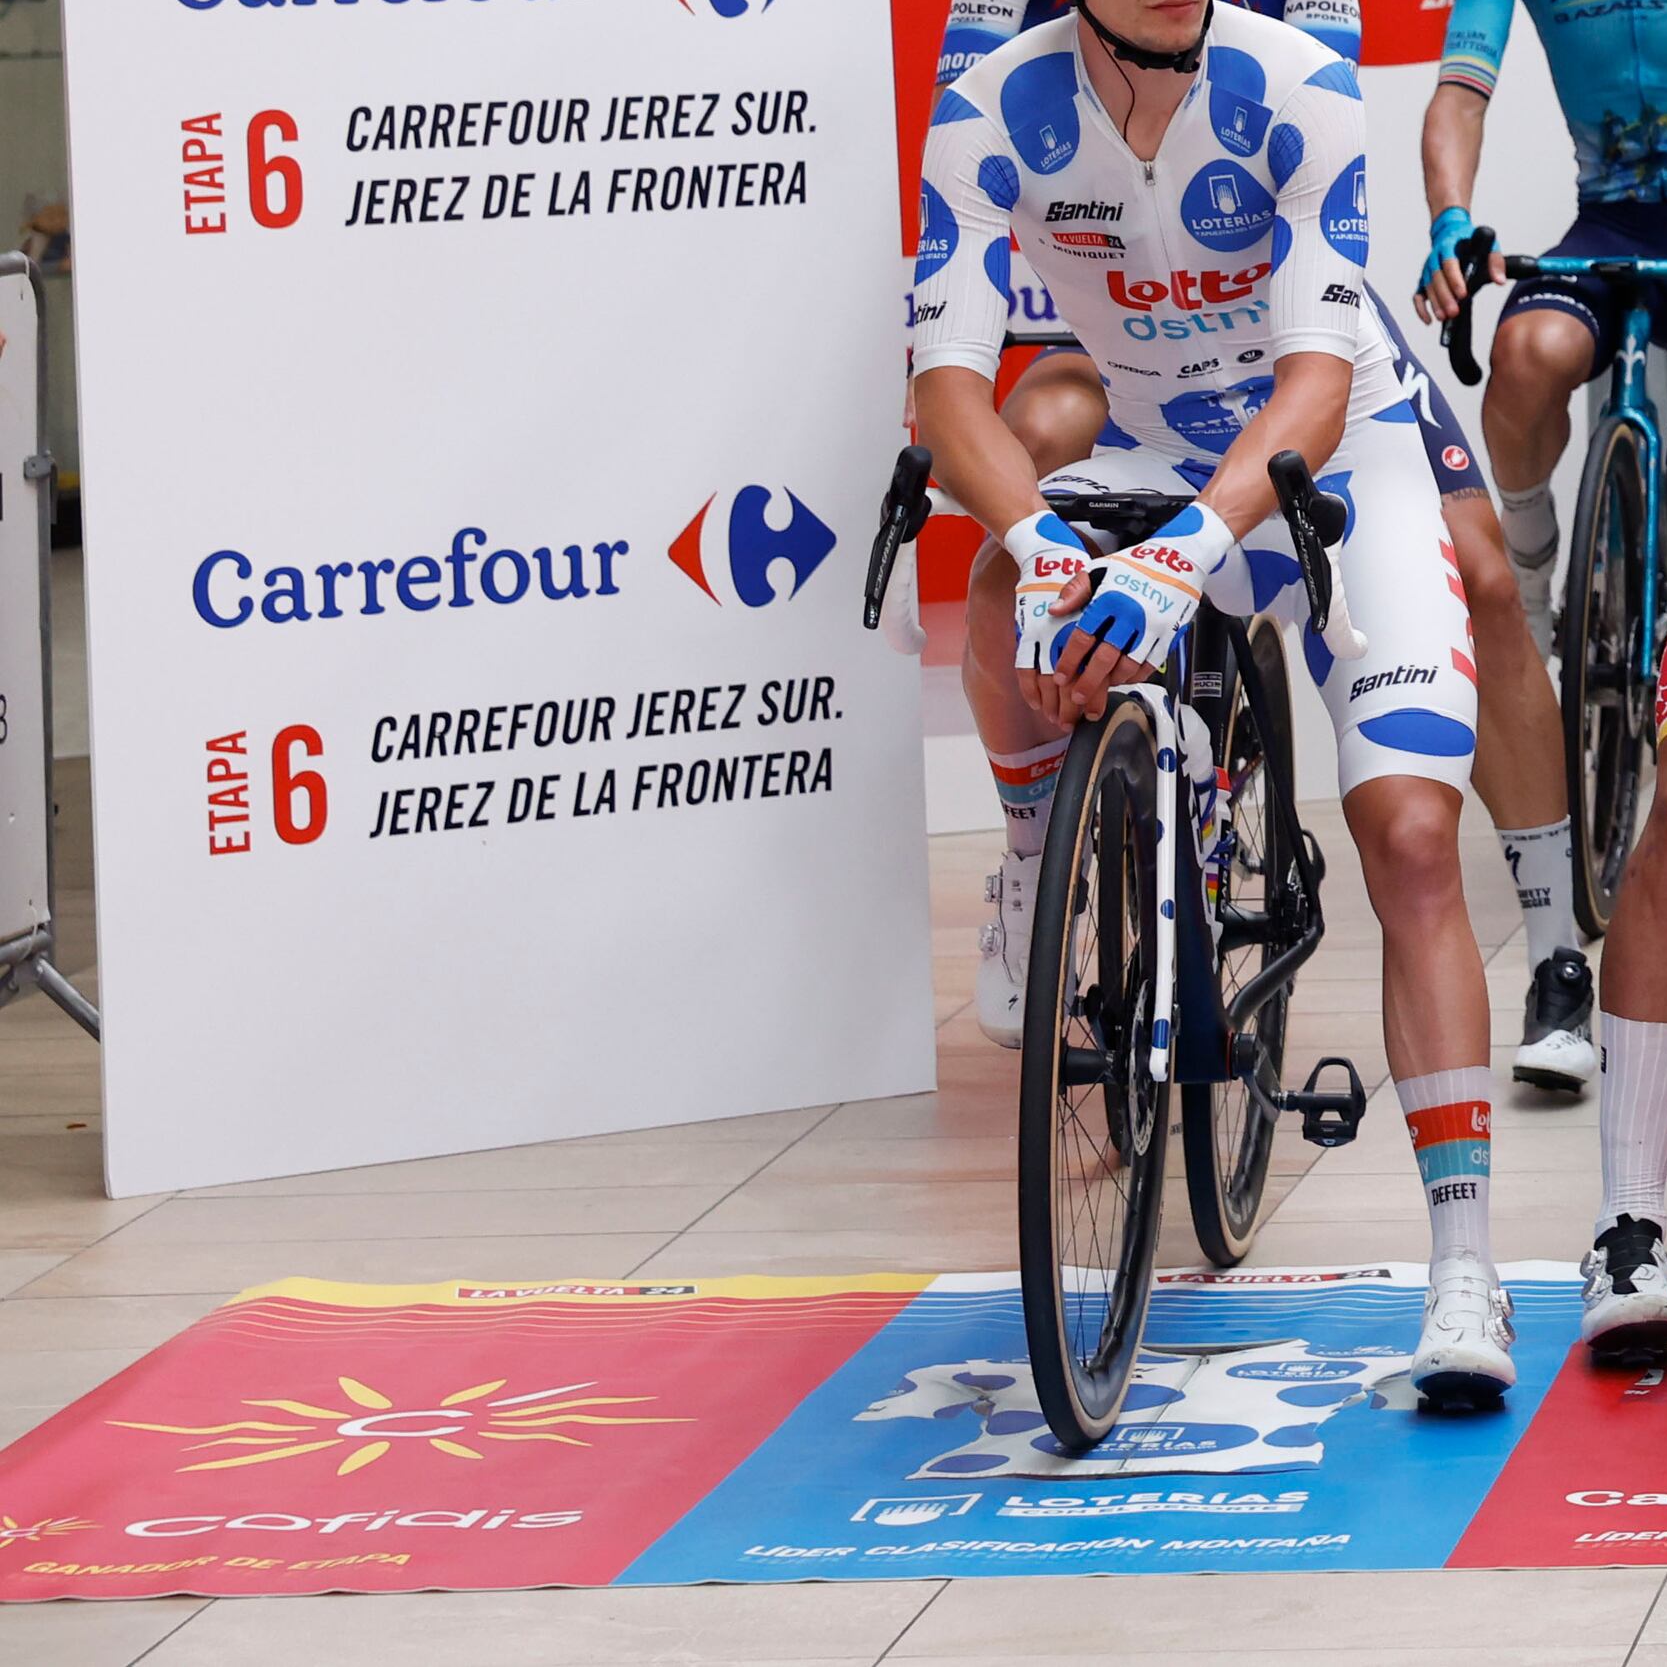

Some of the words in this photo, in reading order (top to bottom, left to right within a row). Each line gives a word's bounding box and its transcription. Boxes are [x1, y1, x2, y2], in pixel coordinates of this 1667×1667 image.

[345, 98, 590, 152] CARREFOUR
[600, 93, 720, 143] JEREZ
[731, 90, 818, 135] SUR.
[181, 111, 228, 235] ETAPA
[246, 109, 304, 230] 6
[345, 177, 466, 227] JEREZ
[482, 172, 532, 219] DE
[548, 170, 593, 216] LA
[606, 160, 807, 214] FRONTERA
[1045, 201, 1124, 222] Santini
[1192, 209, 1272, 230] LOTERÍAS
[1053, 244, 1125, 260] MONIQUET
[1108, 236, 1120, 248] 24
[1107, 361, 1162, 377] ORBEA
[1181, 358, 1220, 375] CAPS
[1088, 501, 1119, 509] GARMIN
[192, 528, 629, 629] Carrefour
[1114, 573, 1174, 613] dstny
[1348, 665, 1440, 703] Santini
[370, 696, 616, 762] CARREFOUR
[626, 684, 746, 740] JEREZ
[759, 676, 845, 722] SUR.
[206, 729, 252, 856] ETAPA
[270, 724, 329, 846] 6
[369, 781, 490, 839] JEREZ
[507, 775, 557, 824] DE
[572, 768, 617, 818] LA
[632, 747, 833, 812] FRONTERA
[1431, 1181, 1478, 1207] DEFEET
[1170, 1272, 1208, 1284] LA
[1214, 1271, 1324, 1285] VUELTA
[1342, 1269, 1384, 1282] 24
[469, 1287, 511, 1299] LA
[514, 1284, 625, 1299] VUELTA
[644, 1285, 690, 1298] 24
[1004, 1491, 1311, 1508] LOTERÍAS
[743, 1544, 856, 1559] LÍDER
[864, 1535, 1154, 1560] CLASIFICACIÓN
[1167, 1532, 1353, 1555] MONTAÑA
[23, 1555, 210, 1577] GANADOR
[225, 1555, 276, 1571] DE
[295, 1551, 412, 1572] ETAPA
